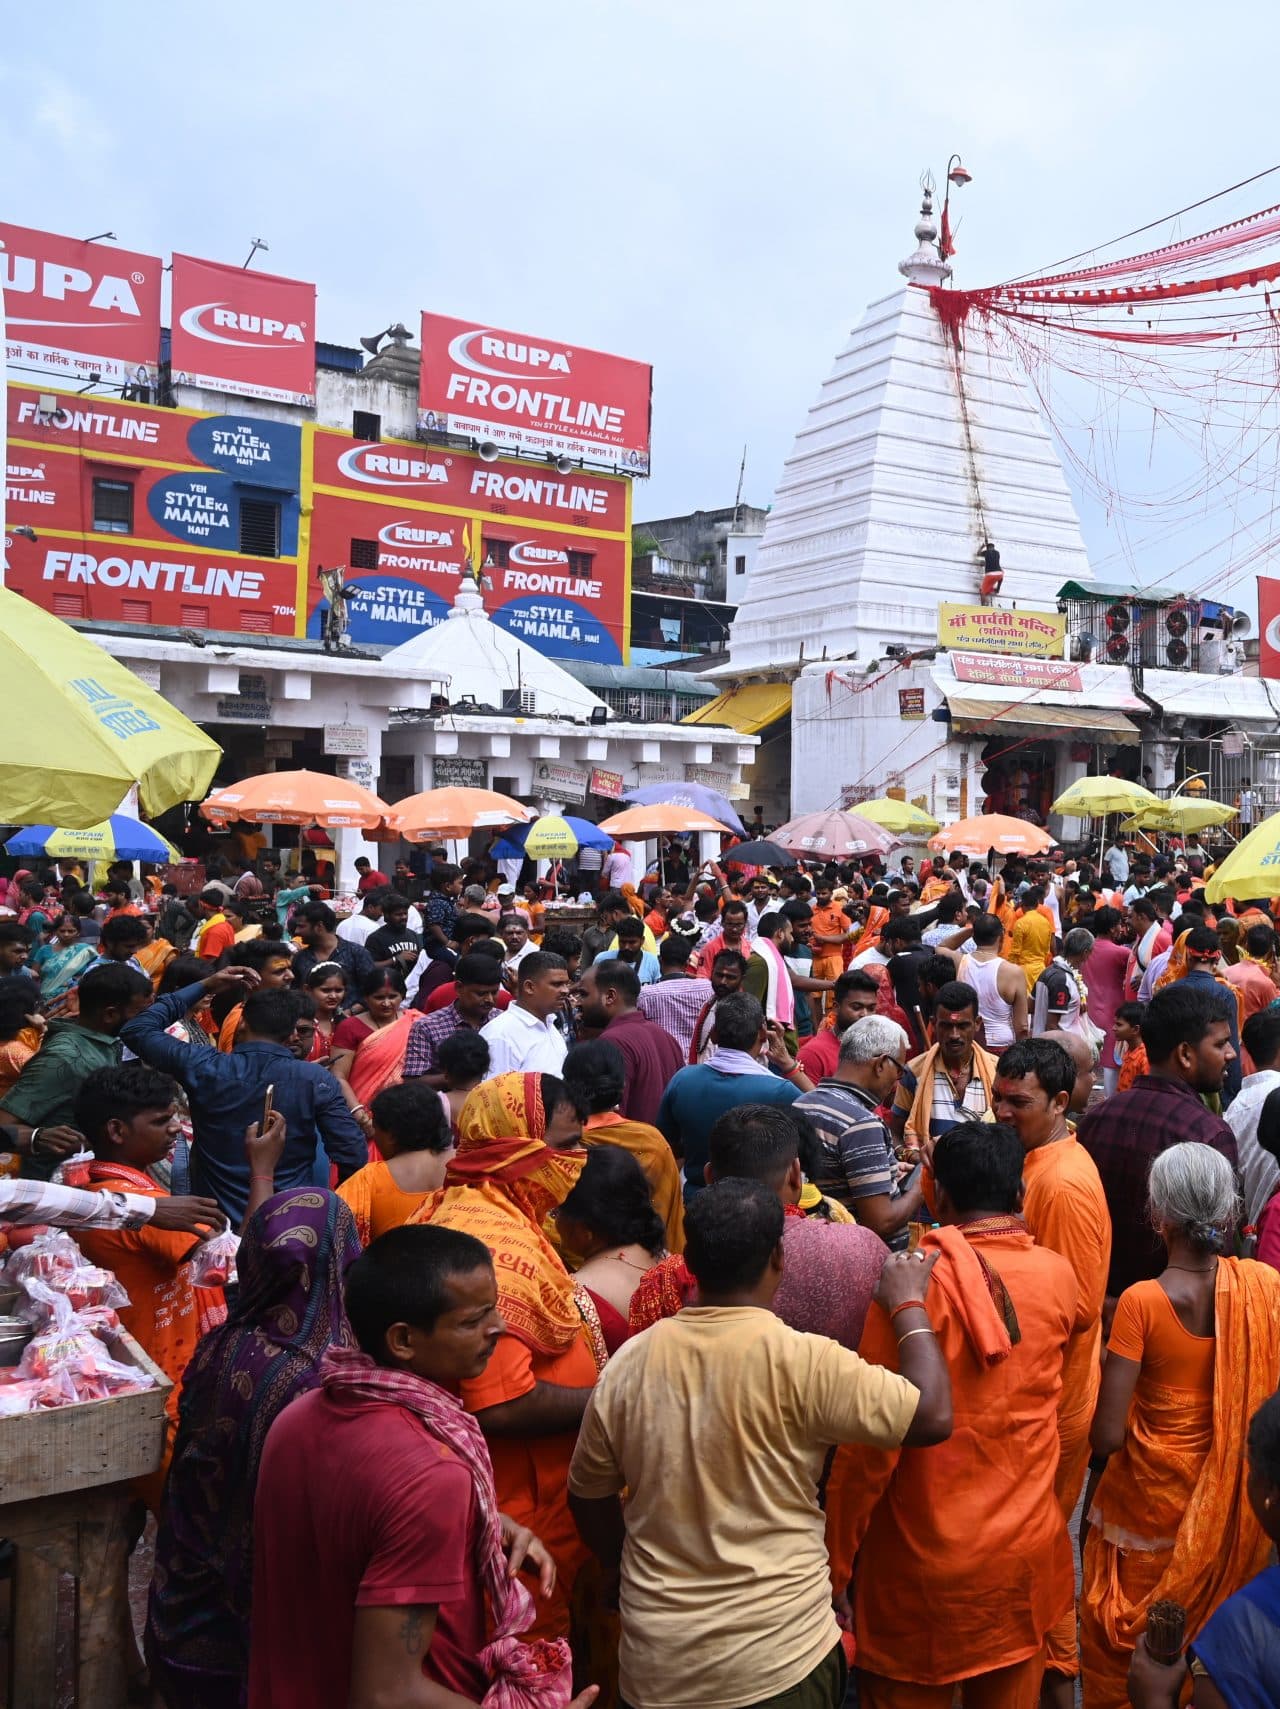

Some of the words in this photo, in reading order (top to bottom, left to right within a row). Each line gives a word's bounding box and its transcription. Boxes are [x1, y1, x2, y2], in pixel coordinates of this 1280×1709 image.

[214, 309, 305, 343] RUPA
[481, 336, 571, 373] RUPA
[446, 373, 625, 434] FRONTLINE
[212, 430, 259, 447] STYLE
[260, 442, 271, 450] KA
[542, 422, 568, 432] STYLE
[580, 430, 609, 440] MAMLA
[213, 443, 271, 461] MAMLA
[365, 452, 449, 483] RUPA
[190, 484, 207, 494] YEH
[470, 470, 608, 514] FRONTLINE
[165, 491, 215, 510] STYLE
[215, 502, 228, 512] KA
[164, 507, 230, 527] MAMLA
[395, 527, 452, 546] RUPA
[378, 553, 461, 575] FRONTLINE
[523, 546, 569, 563] RUPA
[43, 550, 265, 599] FRONTLINE
[504, 570, 602, 598] FRONTLINE
[377, 586, 425, 607] STYLE
[351, 601, 368, 612] KA
[371, 604, 432, 626] MAMLA
[530, 606, 573, 623] STYLE
[509, 619, 523, 628] KA
[524, 621, 580, 640] MAMLA
[970, 612, 1014, 626] पार्वती
[1018, 617, 1057, 638] मन्दिर
[100, 709, 161, 740] STEELS
[1056, 991, 1067, 1006] 3
